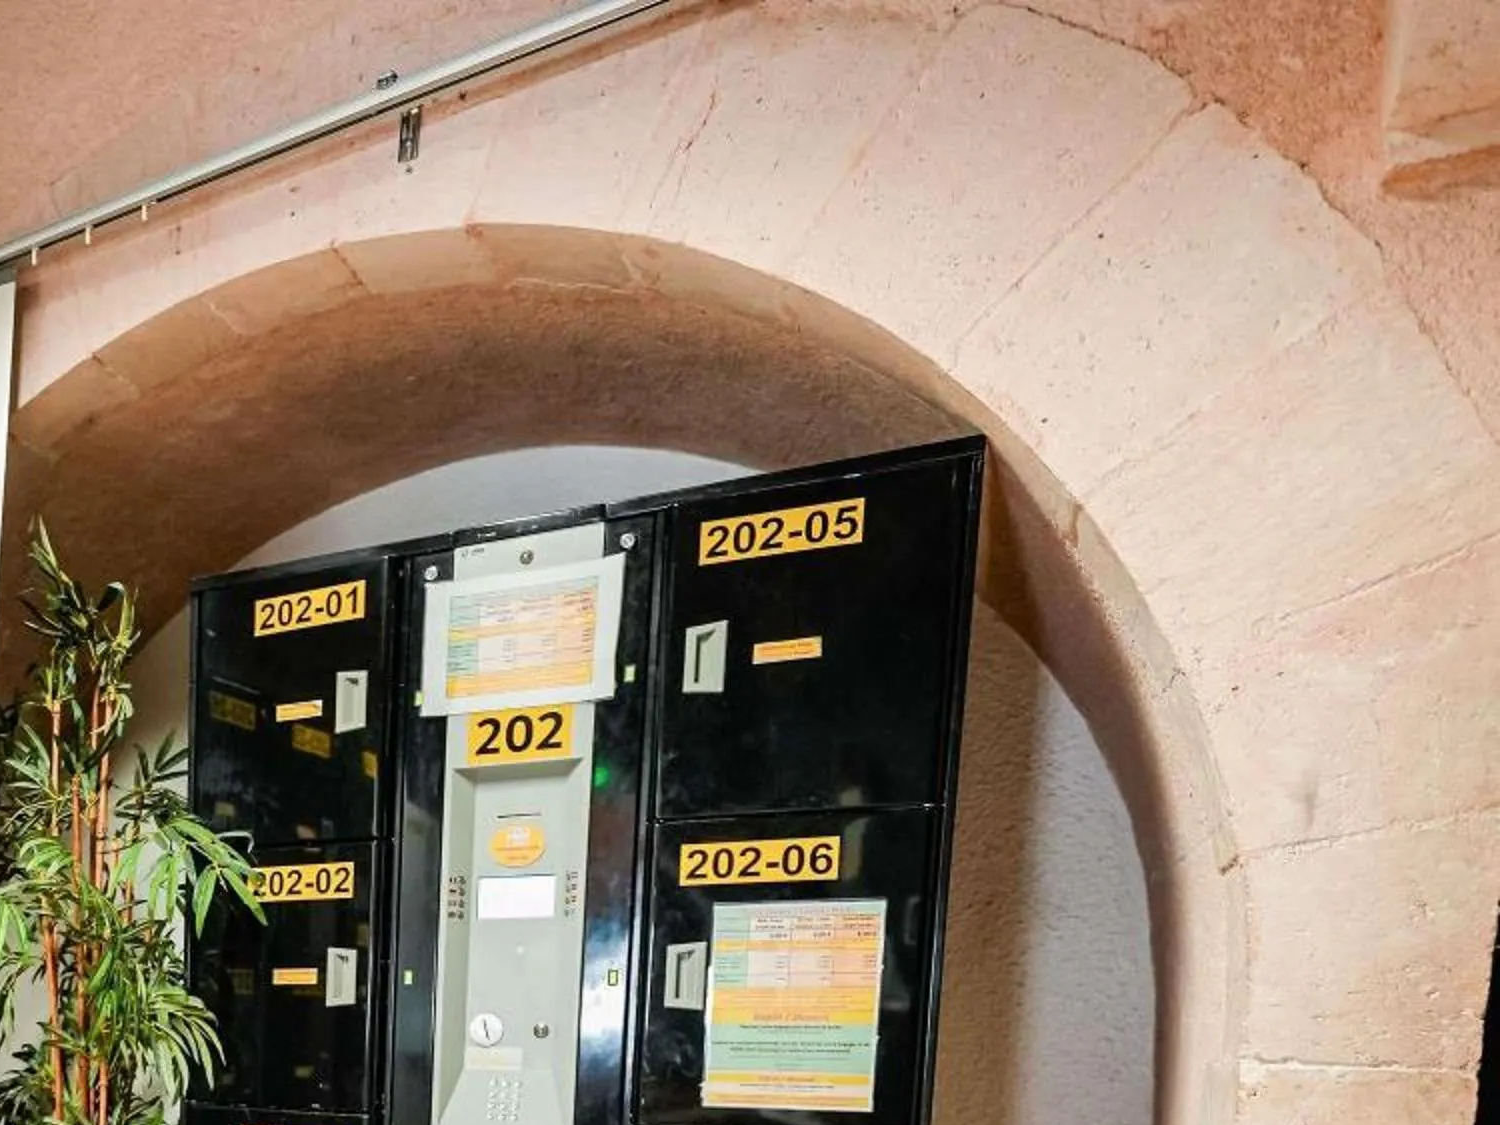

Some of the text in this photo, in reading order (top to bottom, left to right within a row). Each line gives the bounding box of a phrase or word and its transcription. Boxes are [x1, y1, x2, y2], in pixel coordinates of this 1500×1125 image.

[705, 505, 859, 559] 202-05
[259, 586, 358, 631] 202-01
[475, 711, 563, 756] 202
[252, 867, 351, 898] 202-02
[686, 843, 833, 880] 202-06
